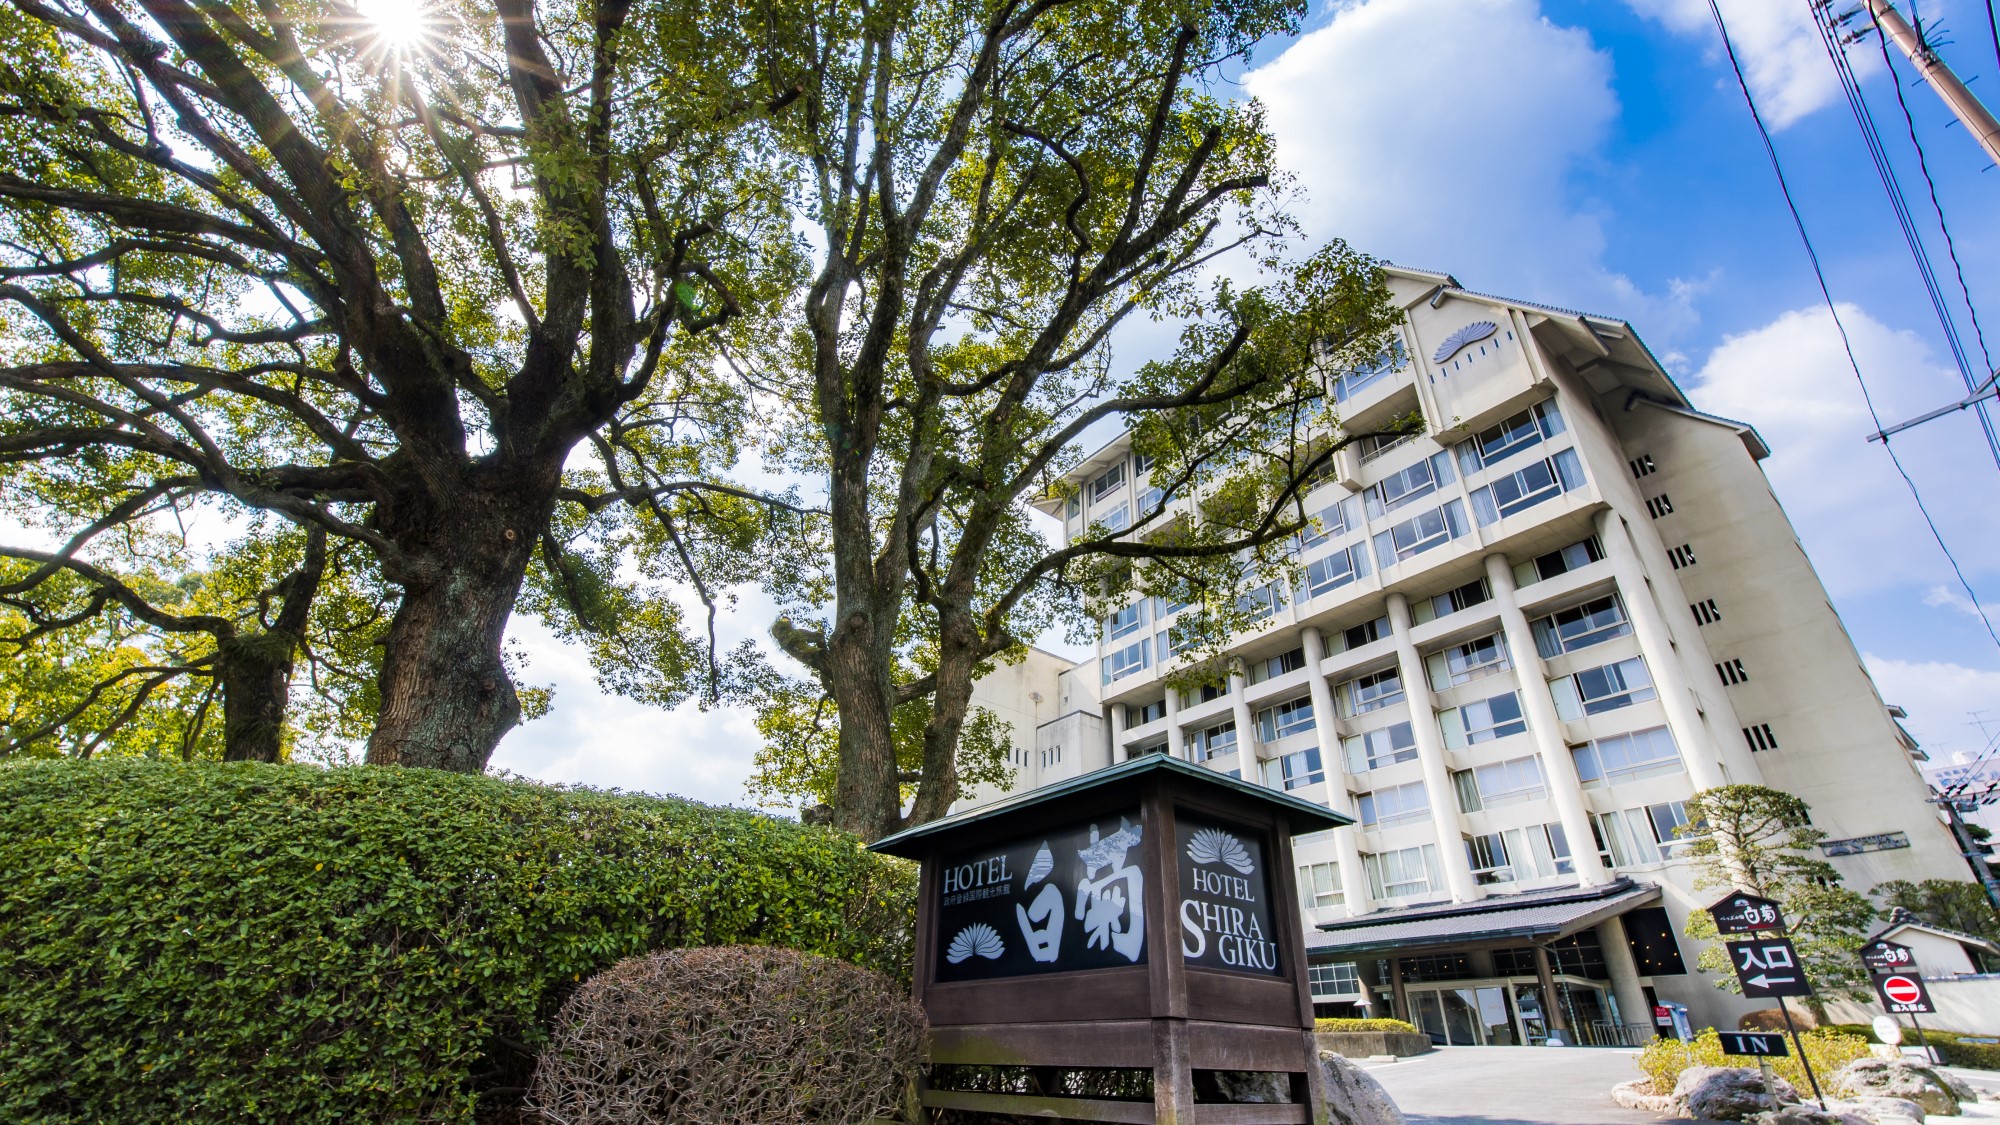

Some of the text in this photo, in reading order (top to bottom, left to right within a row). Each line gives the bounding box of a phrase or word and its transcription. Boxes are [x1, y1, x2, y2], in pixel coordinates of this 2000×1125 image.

[944, 854, 1013, 894] HOTEL
[1016, 816, 1144, 963] 白菊
[1192, 867, 1256, 903] HOTEL
[1180, 898, 1265, 958] SHIRA
[1744, 904, 1776, 925] 白菊
[1218, 935, 1277, 971] GIKU
[1737, 945, 1794, 971] 入口
[1884, 947, 1909, 963] 白菊
[1735, 1036, 1770, 1054] IN
